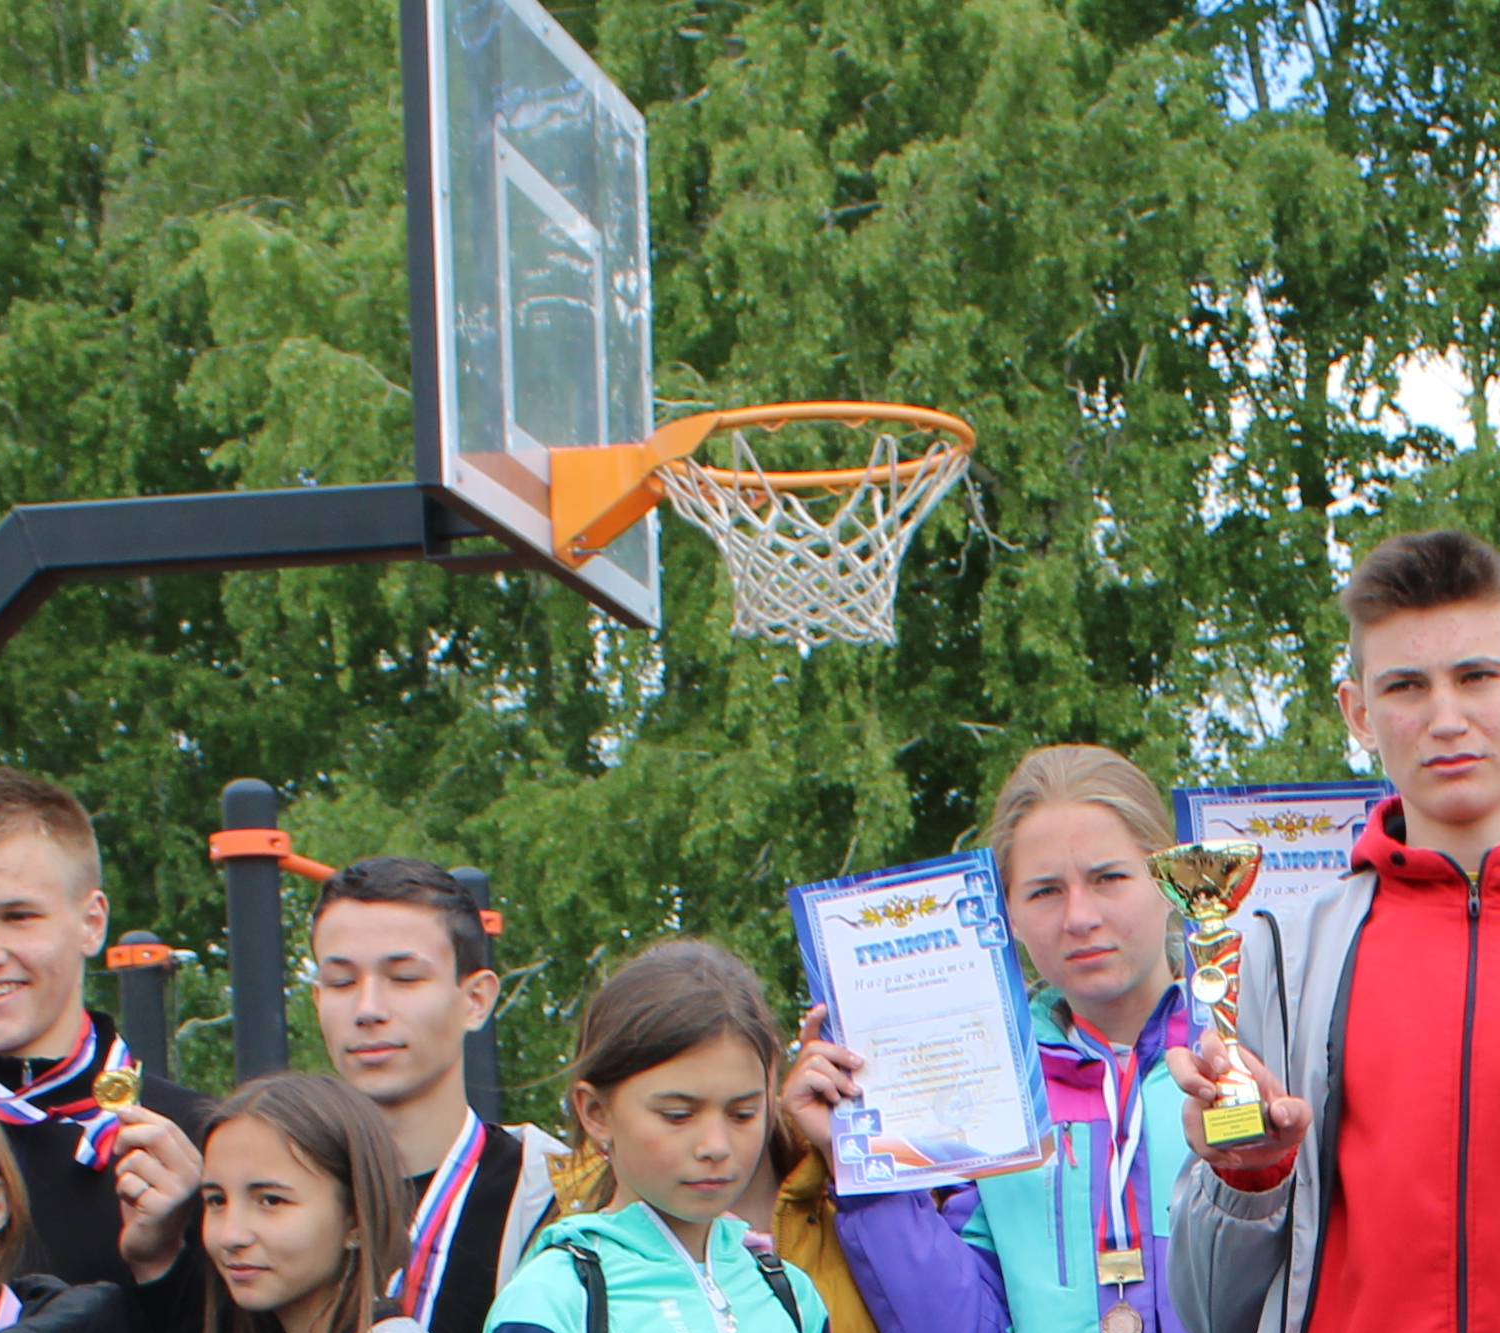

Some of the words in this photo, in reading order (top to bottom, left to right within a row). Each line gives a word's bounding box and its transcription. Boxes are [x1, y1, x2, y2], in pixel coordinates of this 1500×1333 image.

[1261, 849, 1348, 872] АМОТА
[854, 927, 962, 967] ГРАМОТА
[854, 961, 977, 993] Награждается
